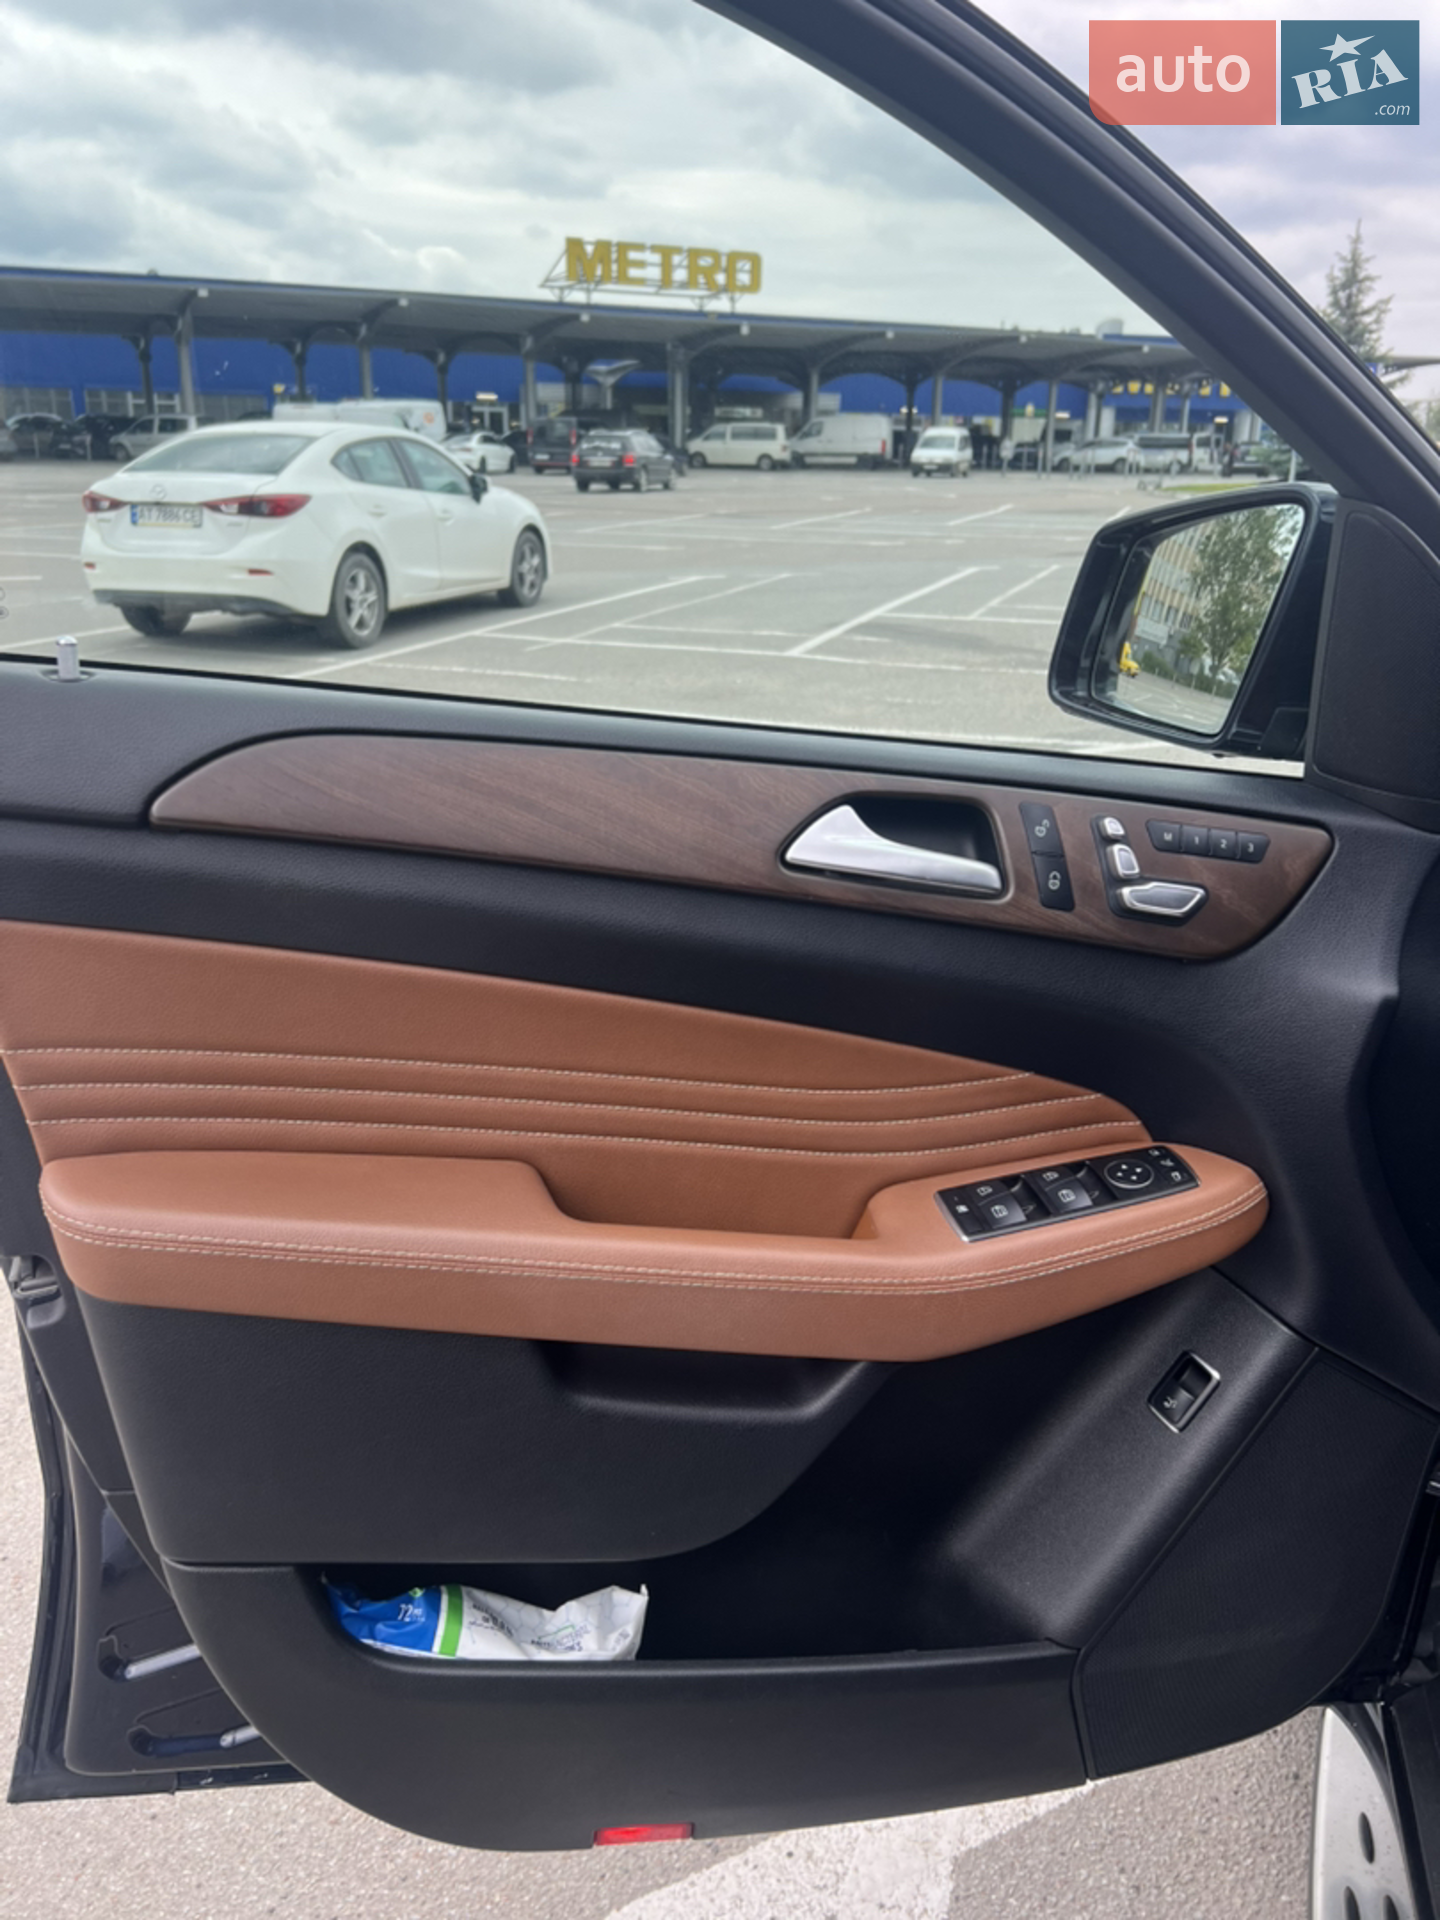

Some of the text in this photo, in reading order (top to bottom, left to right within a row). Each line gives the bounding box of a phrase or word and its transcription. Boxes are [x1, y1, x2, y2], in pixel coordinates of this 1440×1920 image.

[565, 237, 762, 293] METRO
[1220, 838, 1228, 849] 2
[1247, 842, 1255, 853] 3
[397, 1603, 414, 1622] 72
